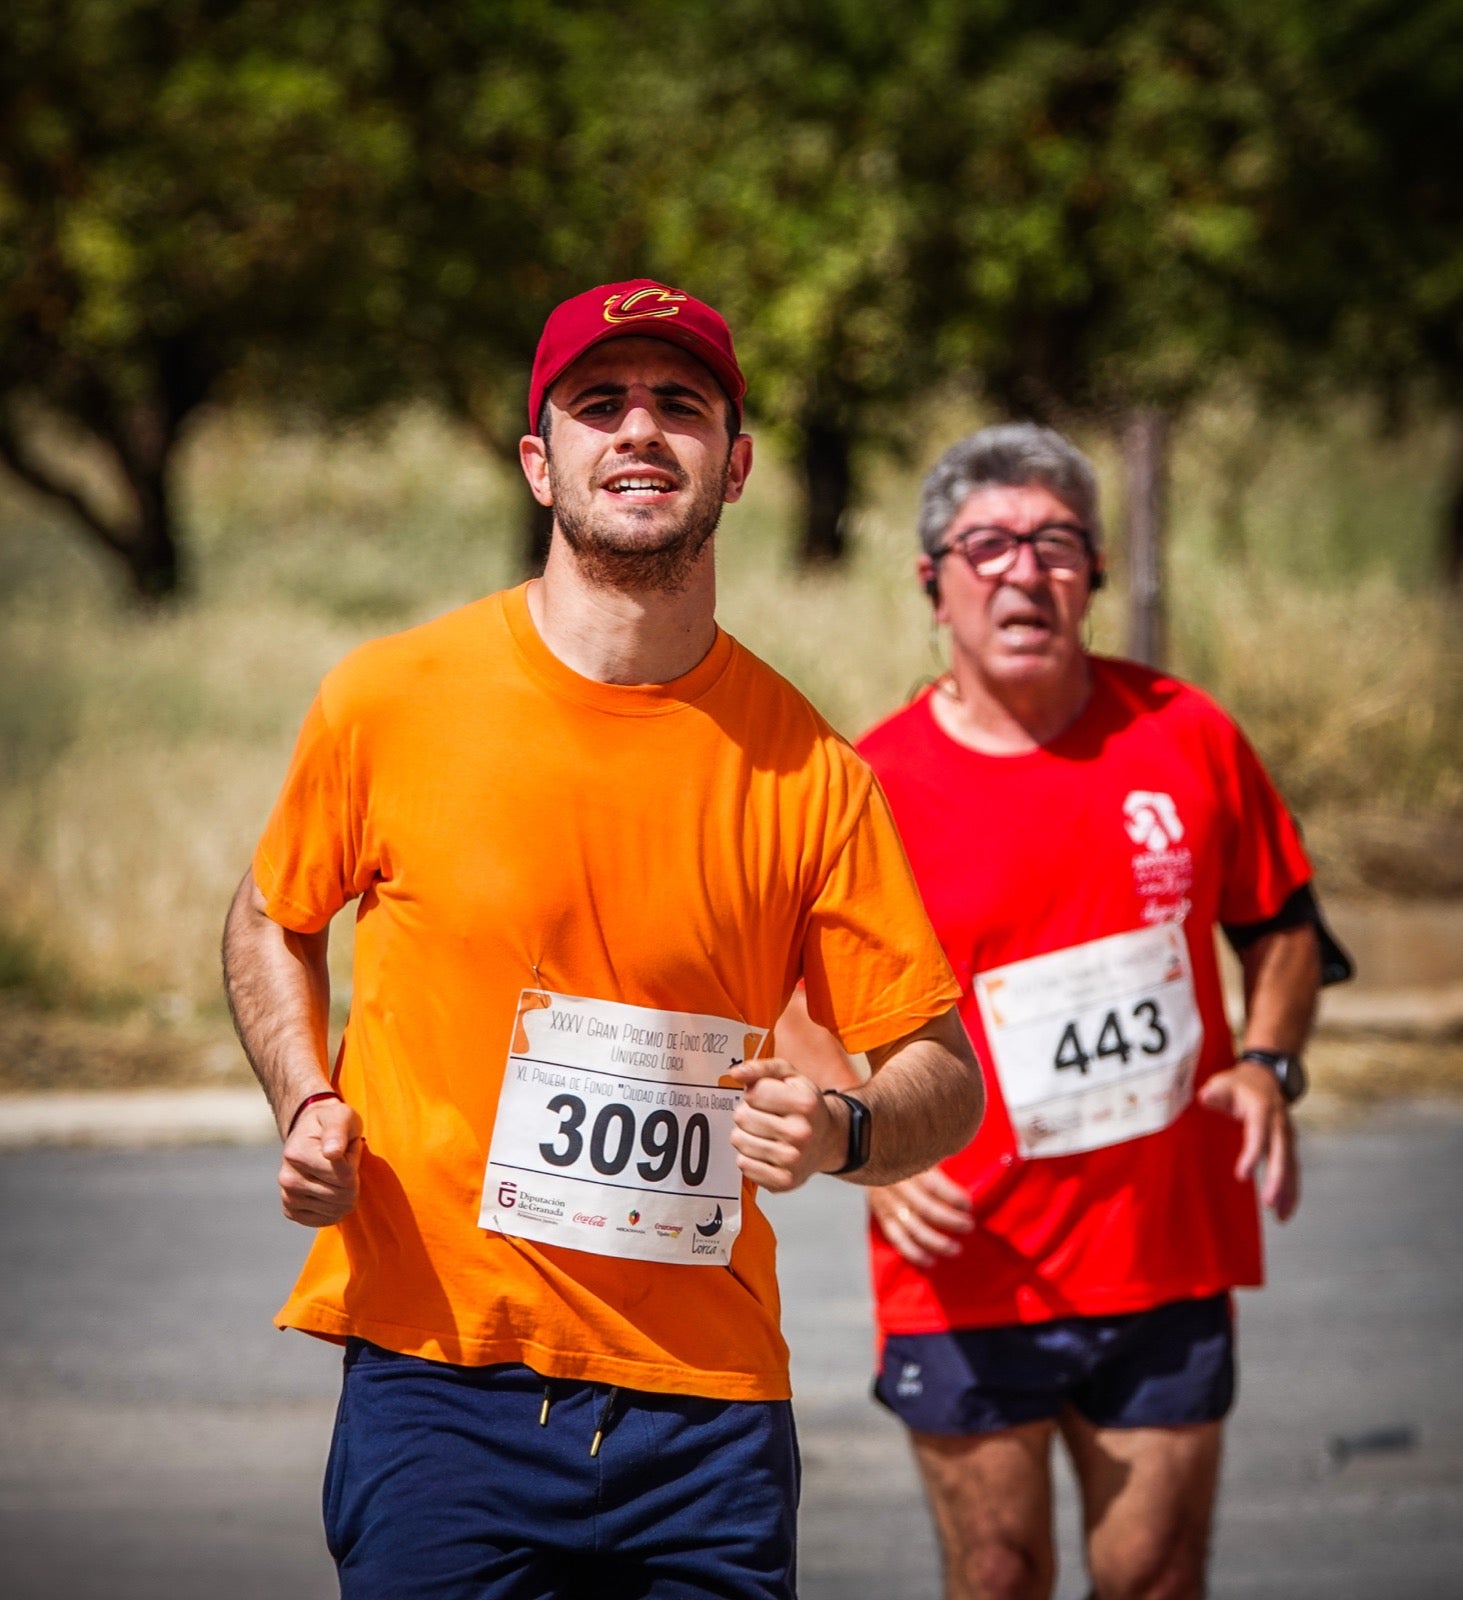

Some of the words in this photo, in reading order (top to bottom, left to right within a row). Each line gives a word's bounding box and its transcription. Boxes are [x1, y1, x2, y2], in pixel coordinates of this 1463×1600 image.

[550, 1010, 583, 1034] XXXV
[702, 1032, 729, 1054] 2022
[1053, 999, 1169, 1075] 443
[517, 1065, 528, 1082] XL
[538, 1093, 711, 1187] 3090
[517, 1201, 528, 1210] de
[528, 1203, 564, 1217] Granada
[519, 1191, 566, 1208] Diputación
[691, 1232, 718, 1255] Lorca
